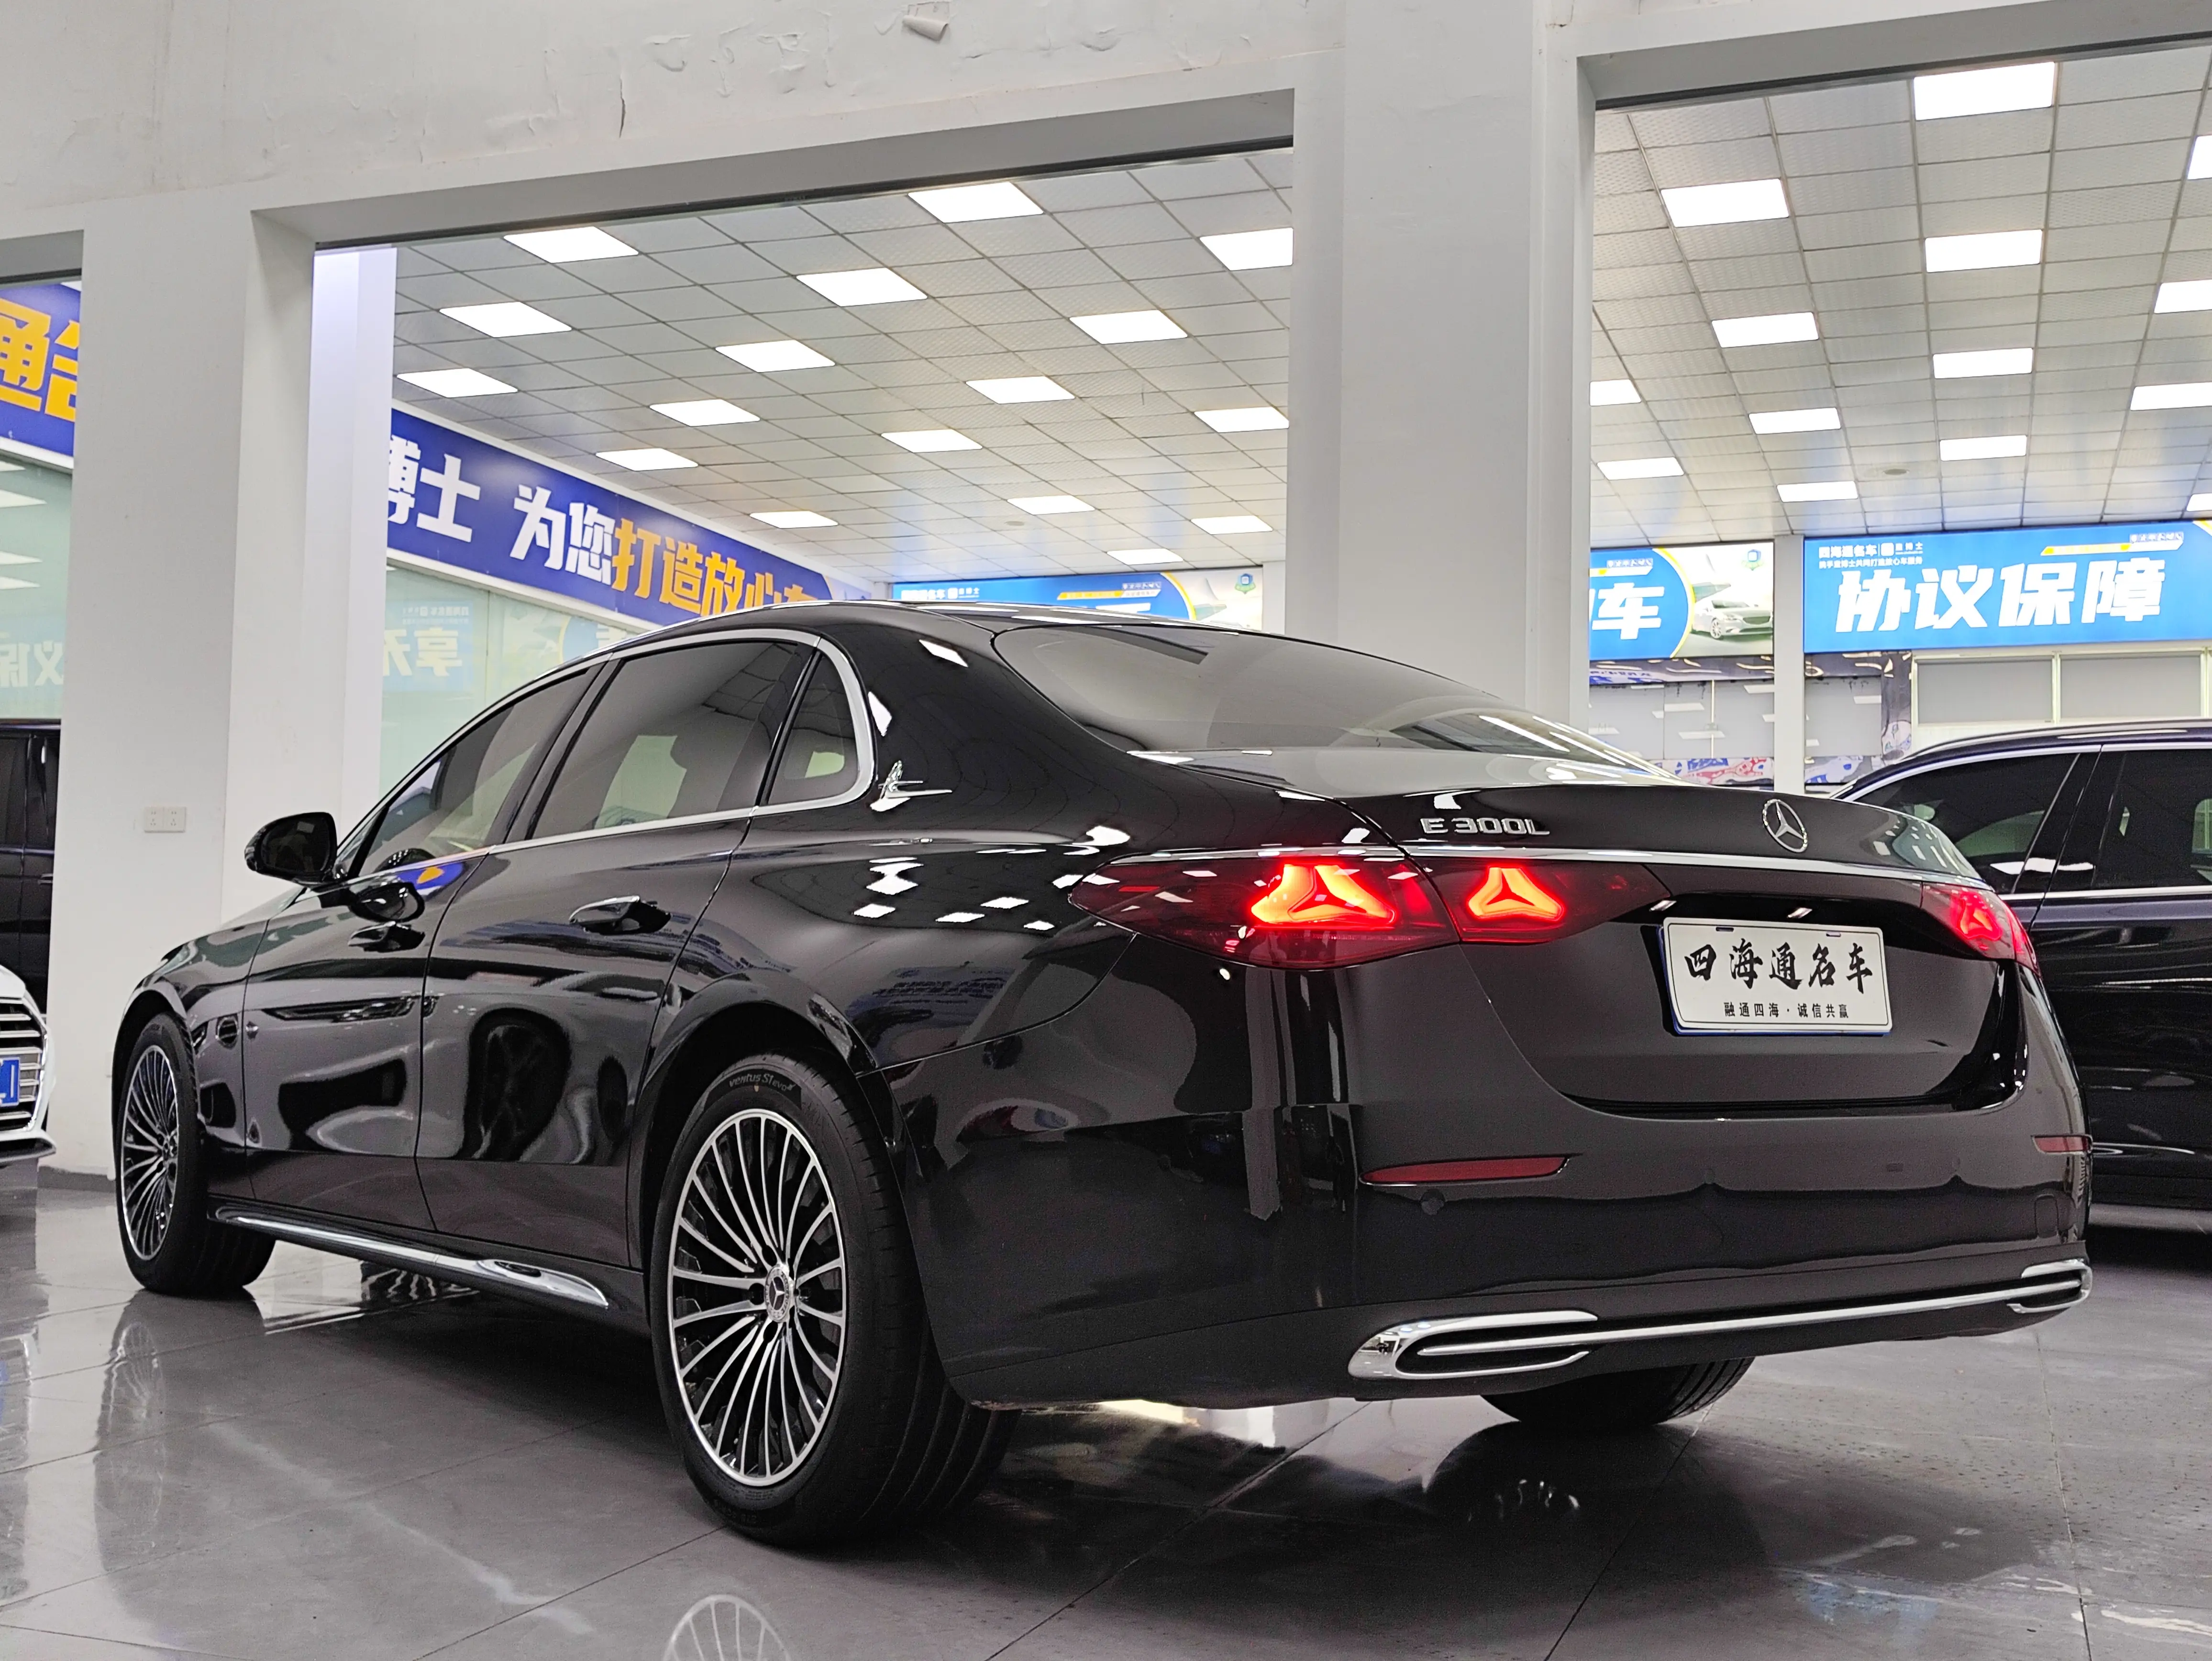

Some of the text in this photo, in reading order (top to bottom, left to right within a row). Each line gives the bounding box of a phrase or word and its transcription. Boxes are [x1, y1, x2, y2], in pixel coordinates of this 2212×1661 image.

[1836, 558, 2166, 632] 协议保障
[1684, 938, 1873, 995] 四海通名车
